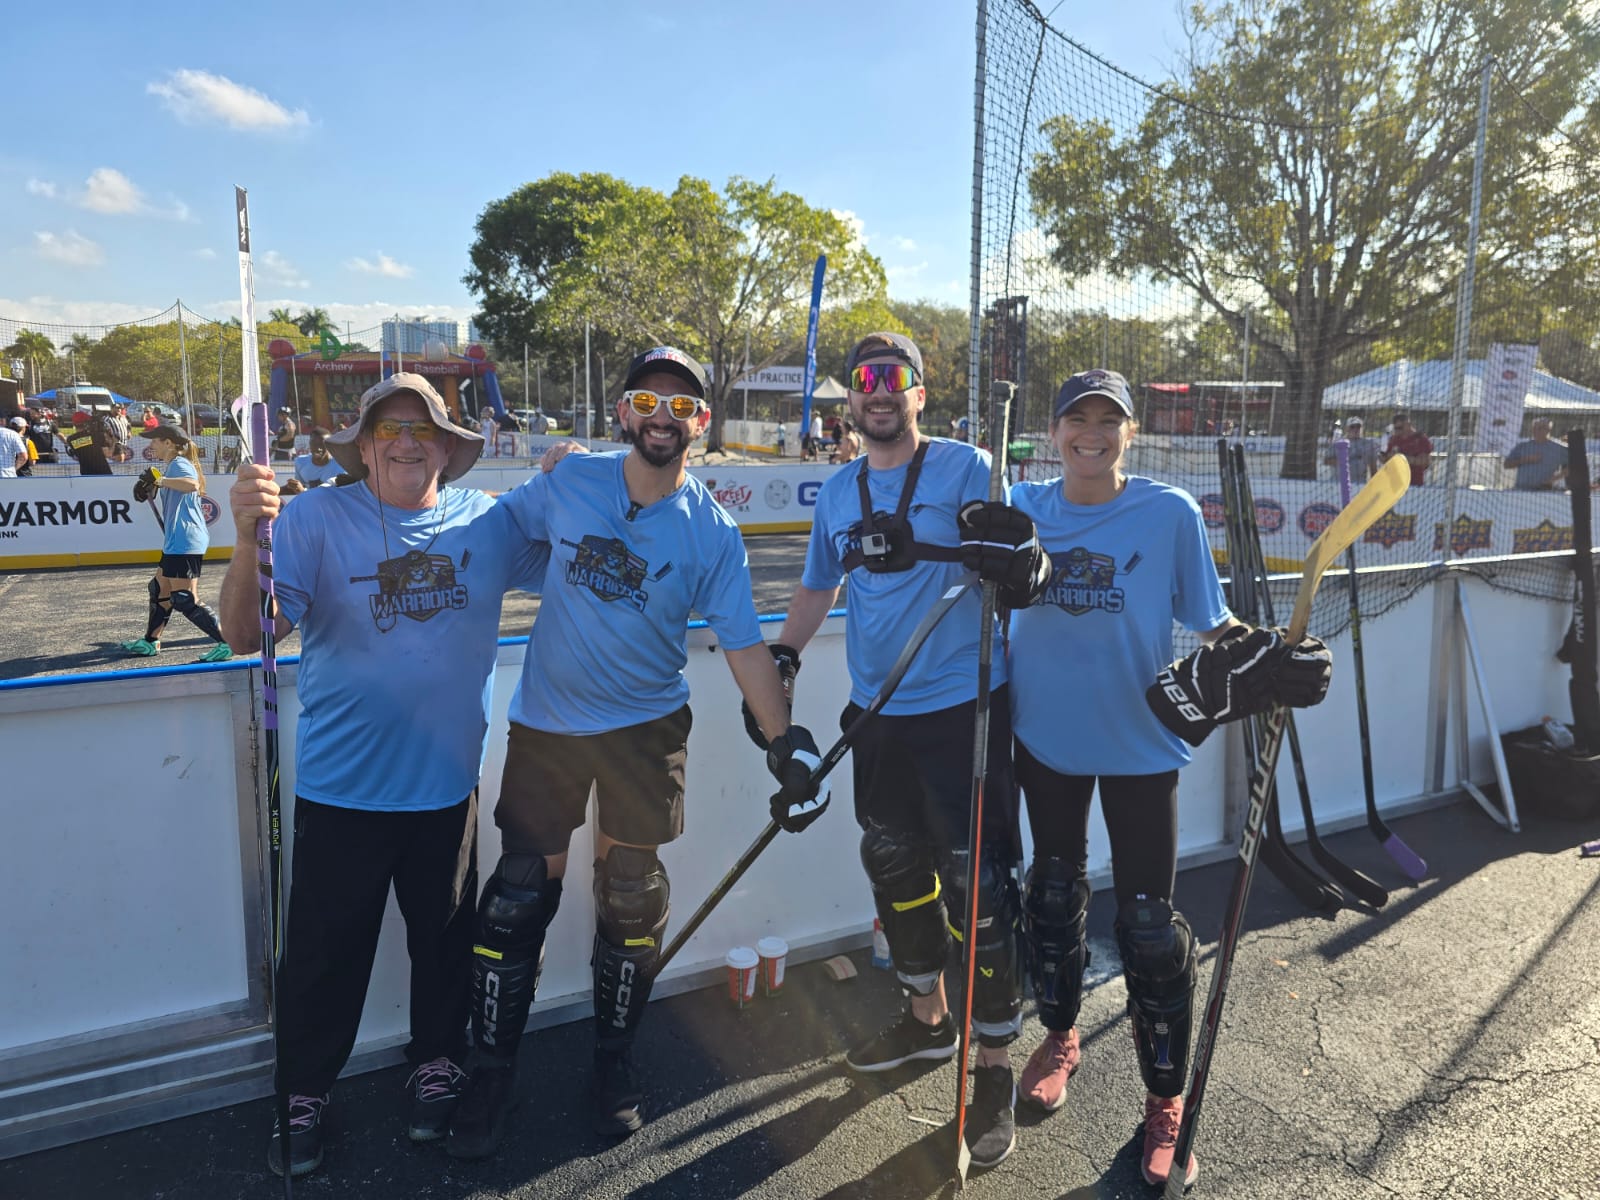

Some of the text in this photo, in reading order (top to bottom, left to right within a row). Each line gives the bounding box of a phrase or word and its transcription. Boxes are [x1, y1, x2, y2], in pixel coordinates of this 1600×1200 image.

[314, 362, 353, 371] Archery
[414, 363, 460, 374] Baseball
[760, 373, 803, 383] PRACTICE
[711, 484, 748, 504] TREET
[368, 584, 469, 618] WARRIORS
[1040, 586, 1125, 613] ARRIORS
[272, 817, 280, 845] POWER
[612, 959, 637, 1029] CCM
[482, 970, 501, 1046] CCM
